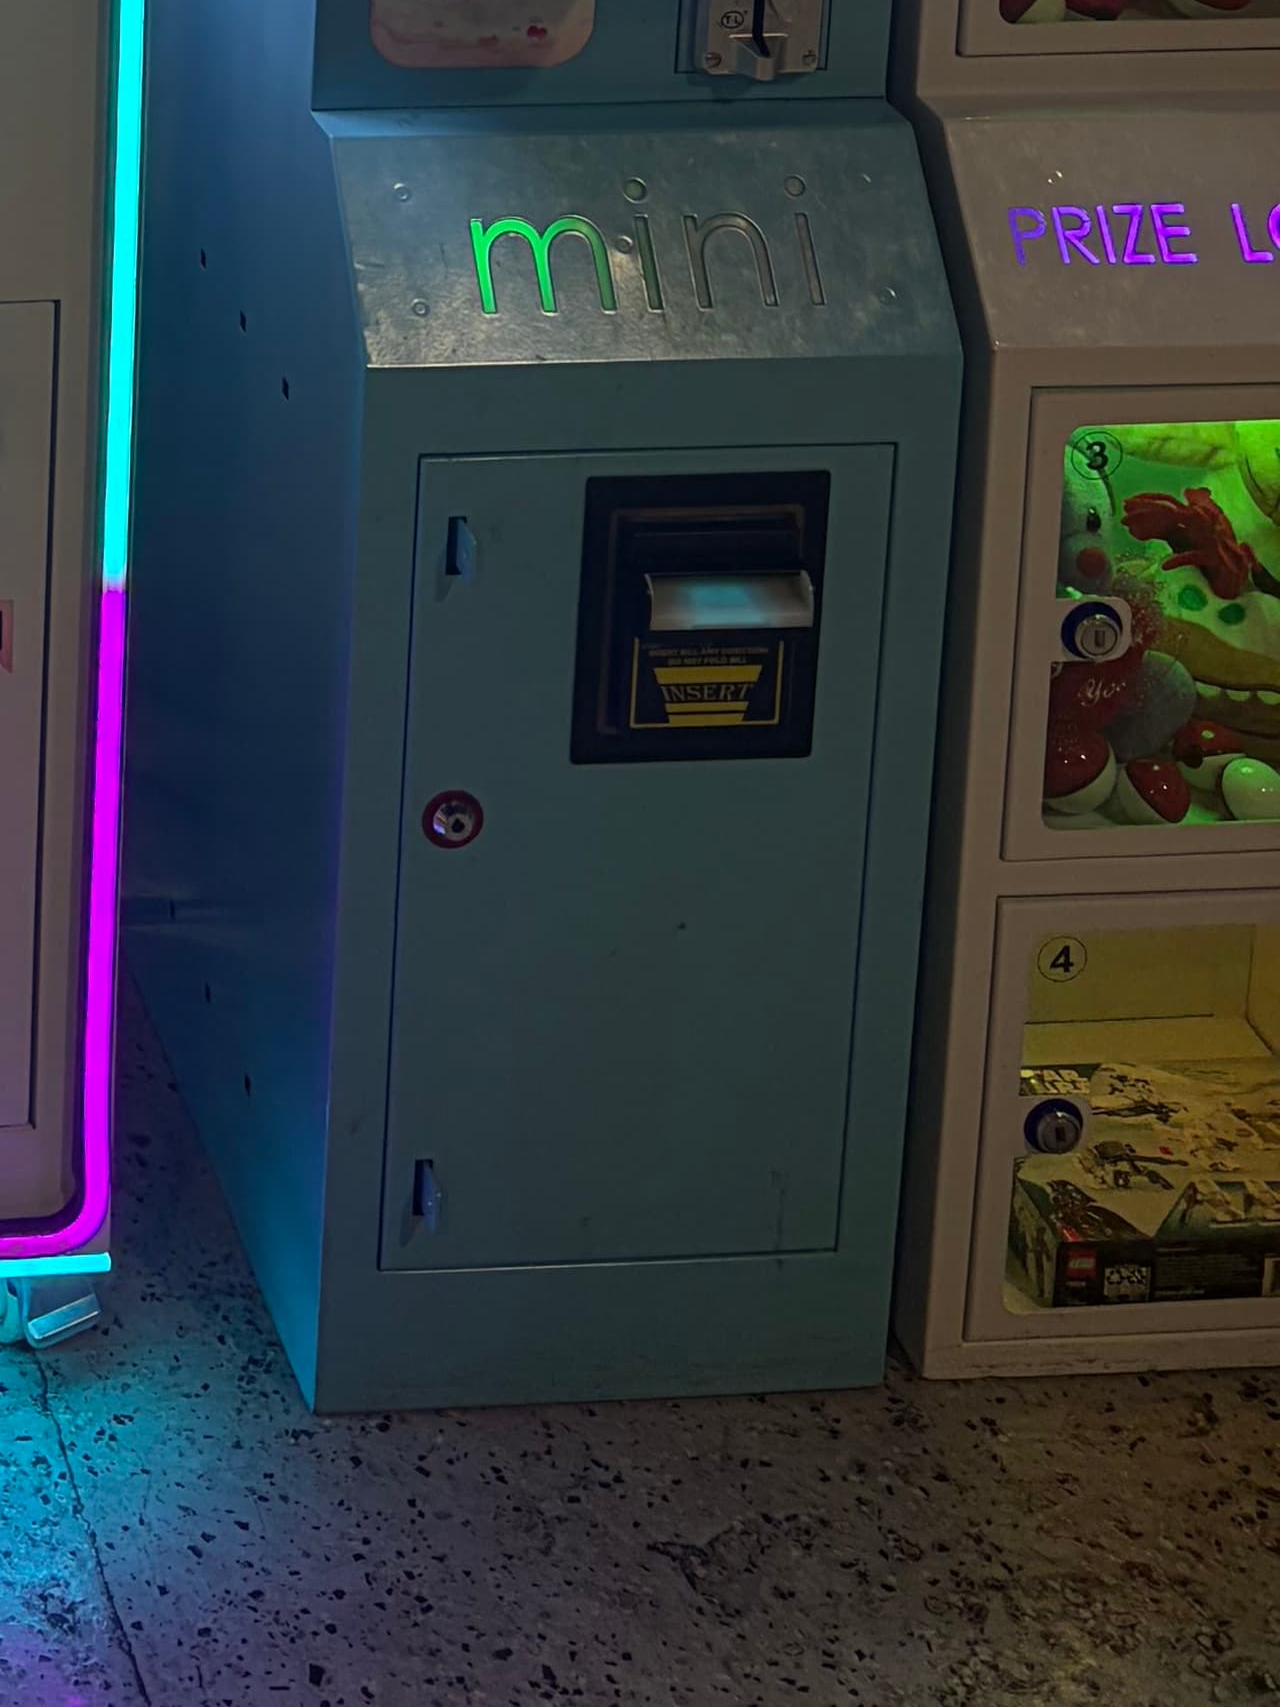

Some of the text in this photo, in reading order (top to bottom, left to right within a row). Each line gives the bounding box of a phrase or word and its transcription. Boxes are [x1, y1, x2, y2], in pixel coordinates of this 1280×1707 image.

[469, 176, 827, 316] mini
[1008, 203, 1199, 267] PRIZE
[1086, 442, 1109, 469] 3
[660, 683, 754, 702] INSERT
[1050, 945, 1074, 973] 4
